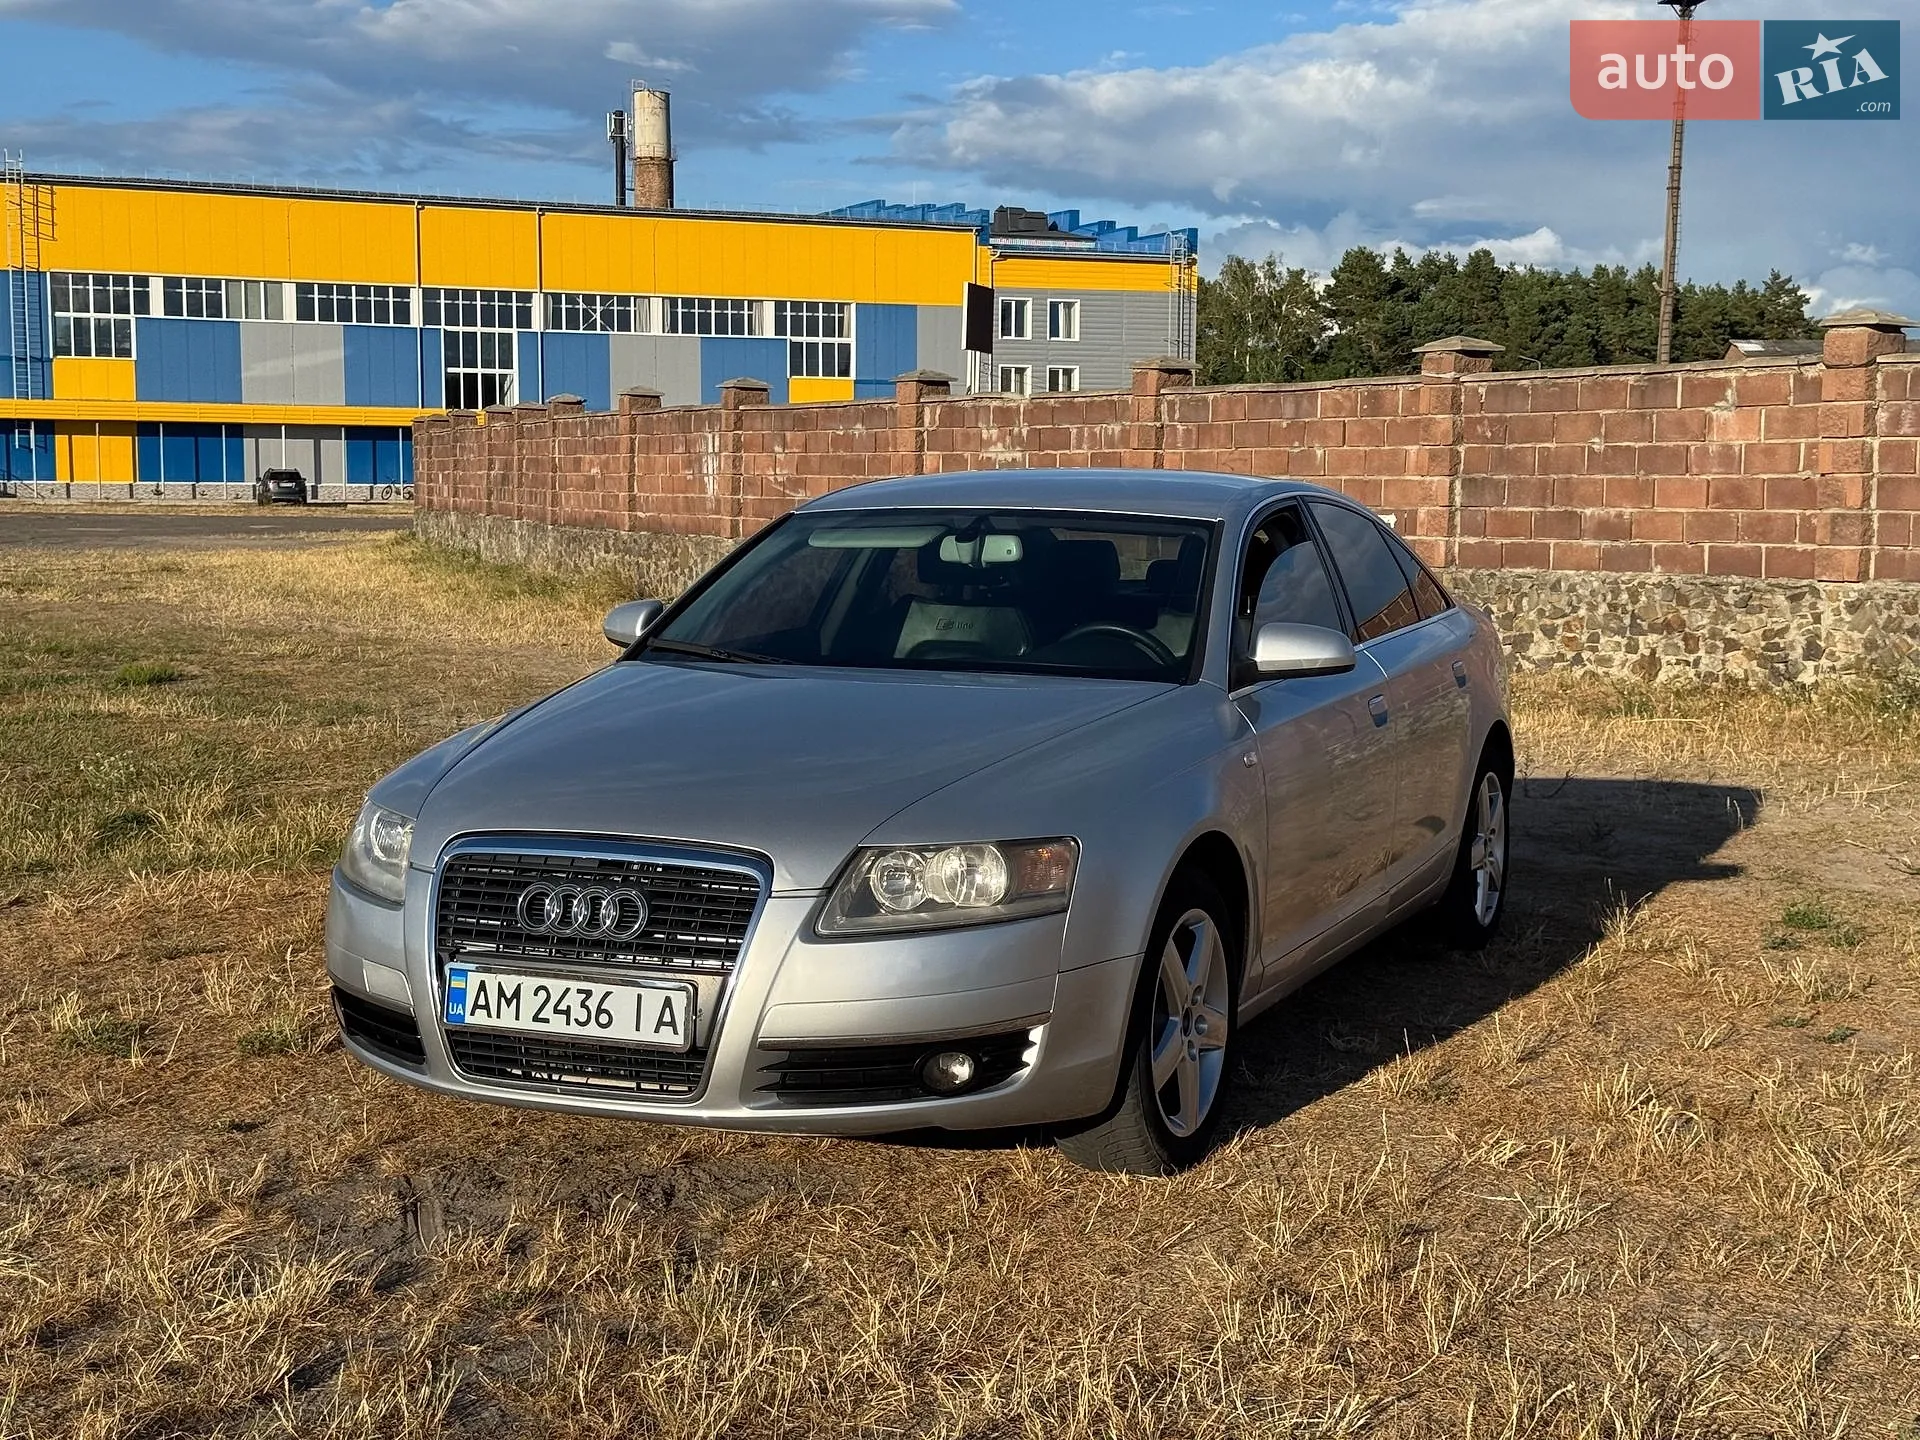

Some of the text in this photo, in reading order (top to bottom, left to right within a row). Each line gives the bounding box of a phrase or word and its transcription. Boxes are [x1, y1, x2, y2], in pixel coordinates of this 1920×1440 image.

[448, 1001, 465, 1016] UA
[469, 979, 679, 1035] AM 2436 IA
